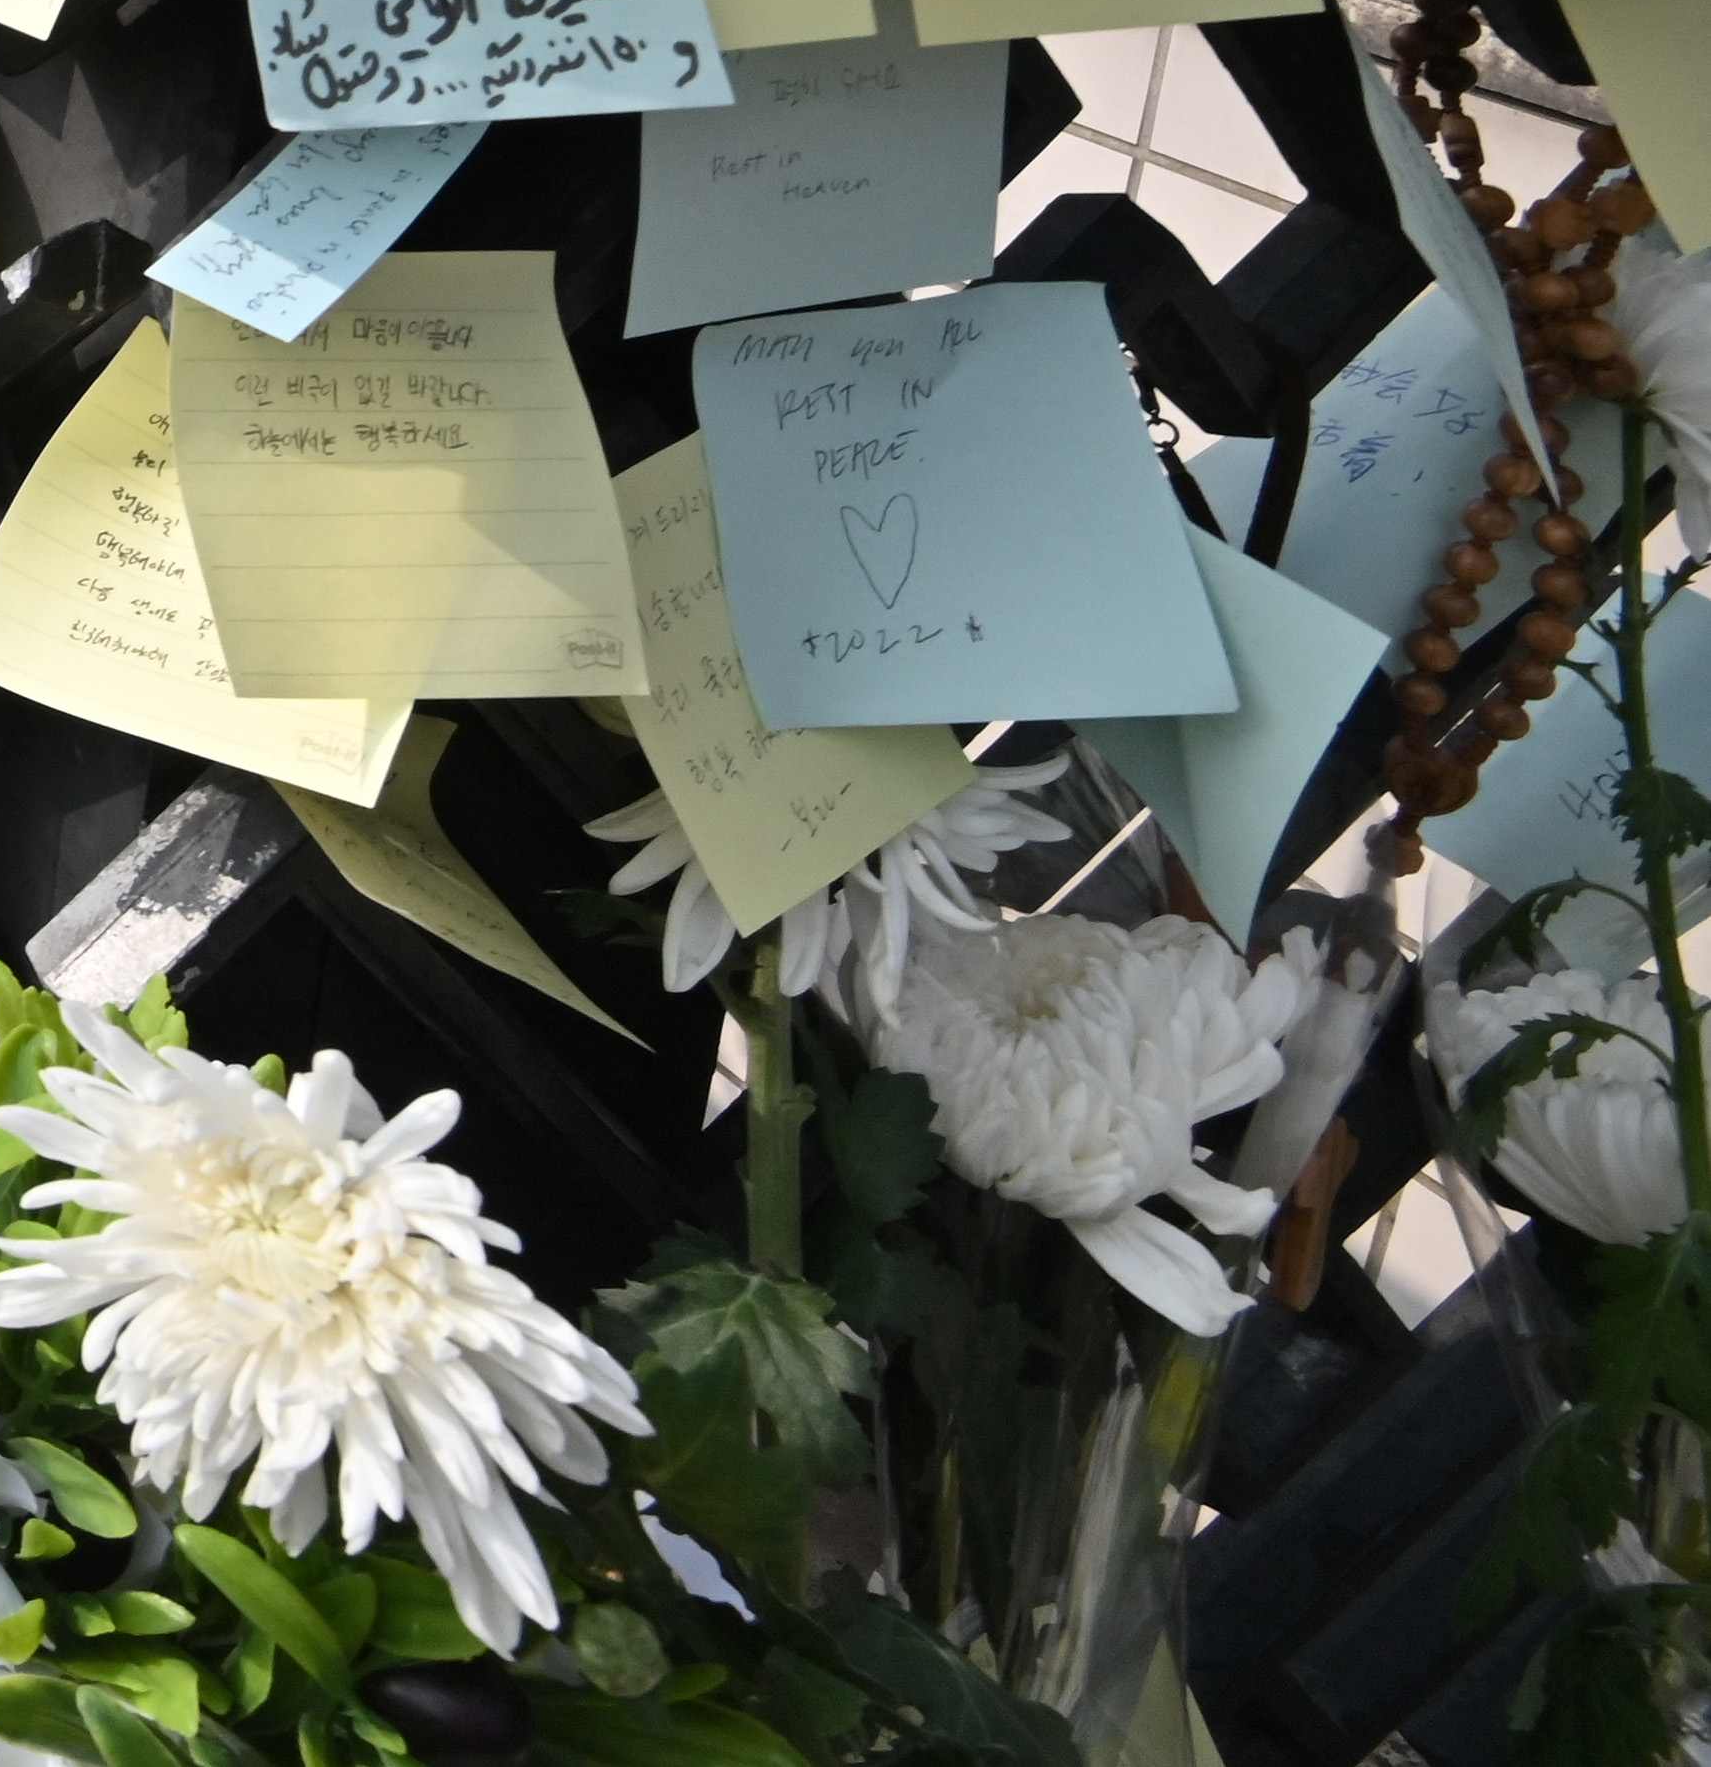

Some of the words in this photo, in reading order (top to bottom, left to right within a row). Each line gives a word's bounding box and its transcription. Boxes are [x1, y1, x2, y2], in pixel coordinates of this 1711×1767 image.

[711, 151, 768, 183] Rest
[779, 147, 805, 170] in
[782, 177, 873, 202] Heaven
[285, 373, 339, 420] 비극이
[775, 381, 856, 431] REST
[900, 377, 934, 410] IN
[242, 422, 339, 458] 하늘에서는
[566, 640, 620, 657] Post-it
